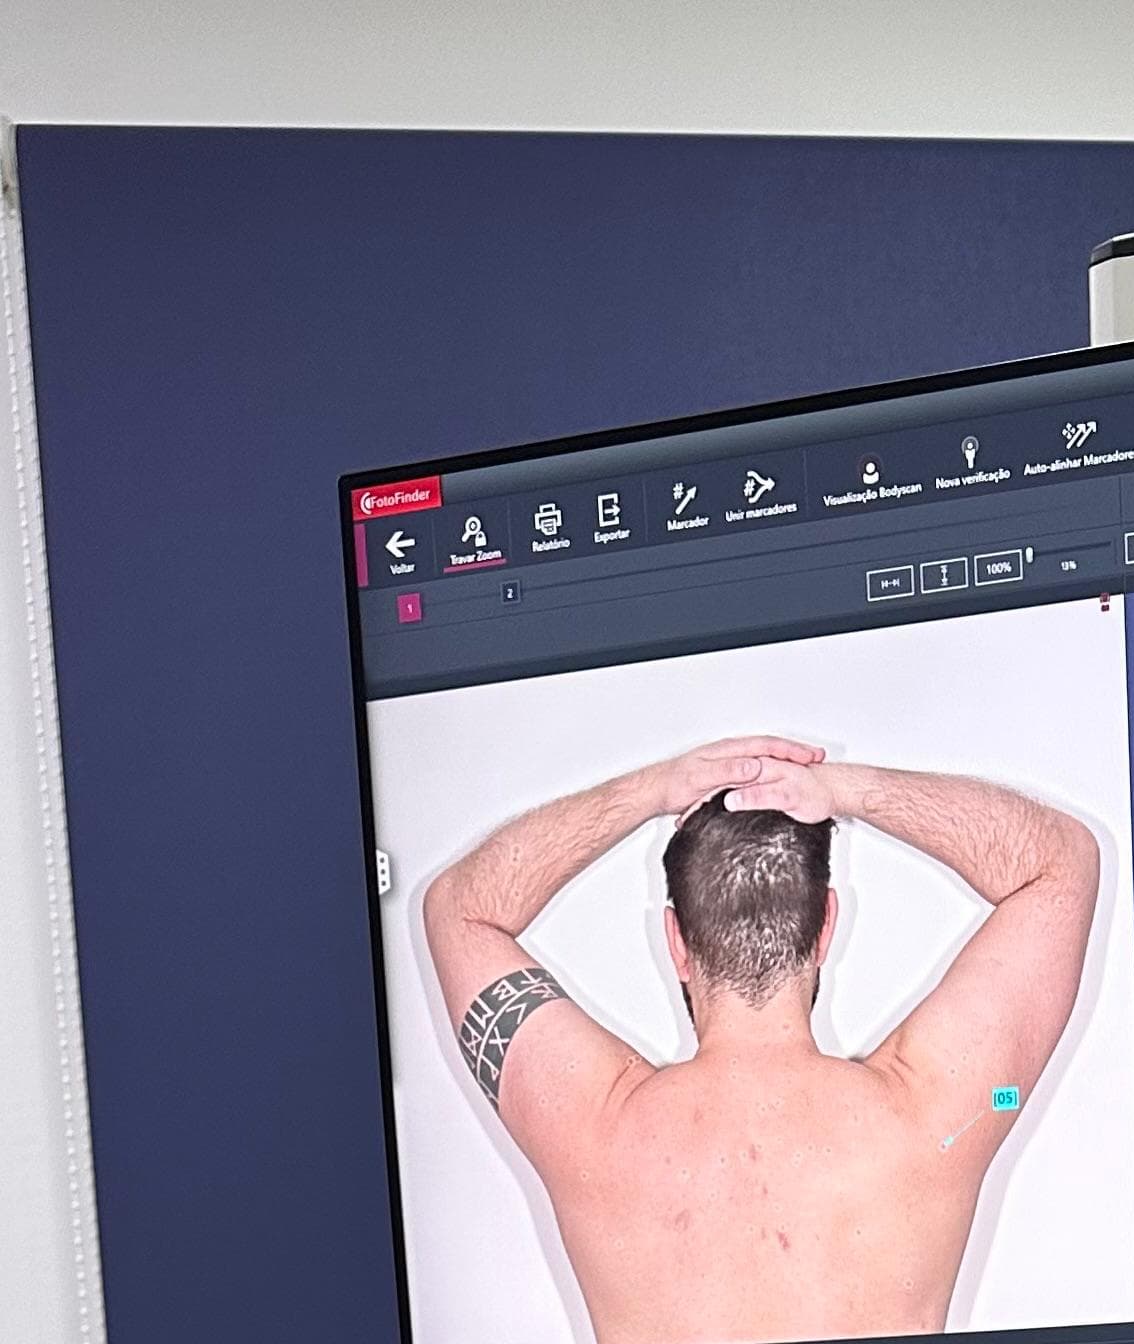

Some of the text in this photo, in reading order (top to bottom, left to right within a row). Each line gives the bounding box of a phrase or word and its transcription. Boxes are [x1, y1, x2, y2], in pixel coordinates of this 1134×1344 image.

[1024, 459, 1081, 475] Auto-alinhar
[935, 469, 1011, 489] Nova verificação
[371, 490, 430, 508] FotoFinder
[823, 483, 922, 506] Visualização Bodyscan
[725, 503, 798, 522] Unir marcadores
[667, 516, 709, 531] Marcador
[594, 529, 630, 544] Exportar
[532, 538, 571, 552] Relatório
[450, 550, 502, 565] Travar Zoom
[390, 563, 415, 575] Voltar
[986, 562, 1012, 575] 100%
[507, 588, 514, 599] 2
[993, 1091, 1018, 1107] [05]
